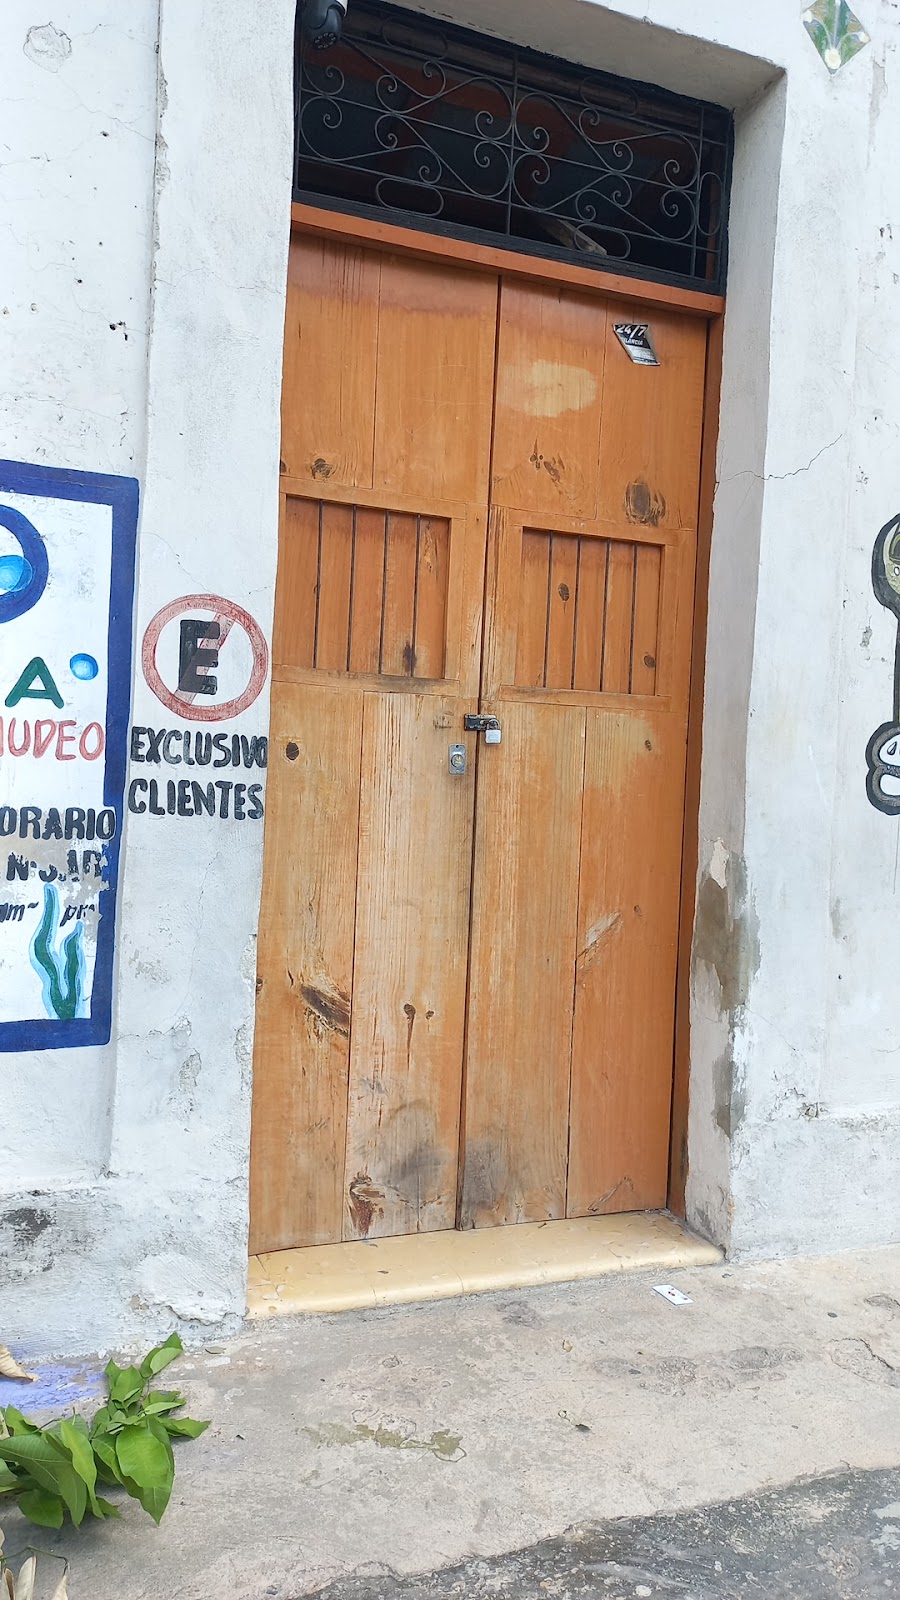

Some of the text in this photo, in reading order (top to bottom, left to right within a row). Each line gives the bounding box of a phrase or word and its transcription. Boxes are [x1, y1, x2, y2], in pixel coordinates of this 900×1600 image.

[616, 325, 647, 338] 24/7
[178, 619, 221, 695] E
[0, 716, 105, 761] UDEO
[131, 726, 268, 769] EXCLUSIVO
[128, 778, 264, 820] CLIENTES
